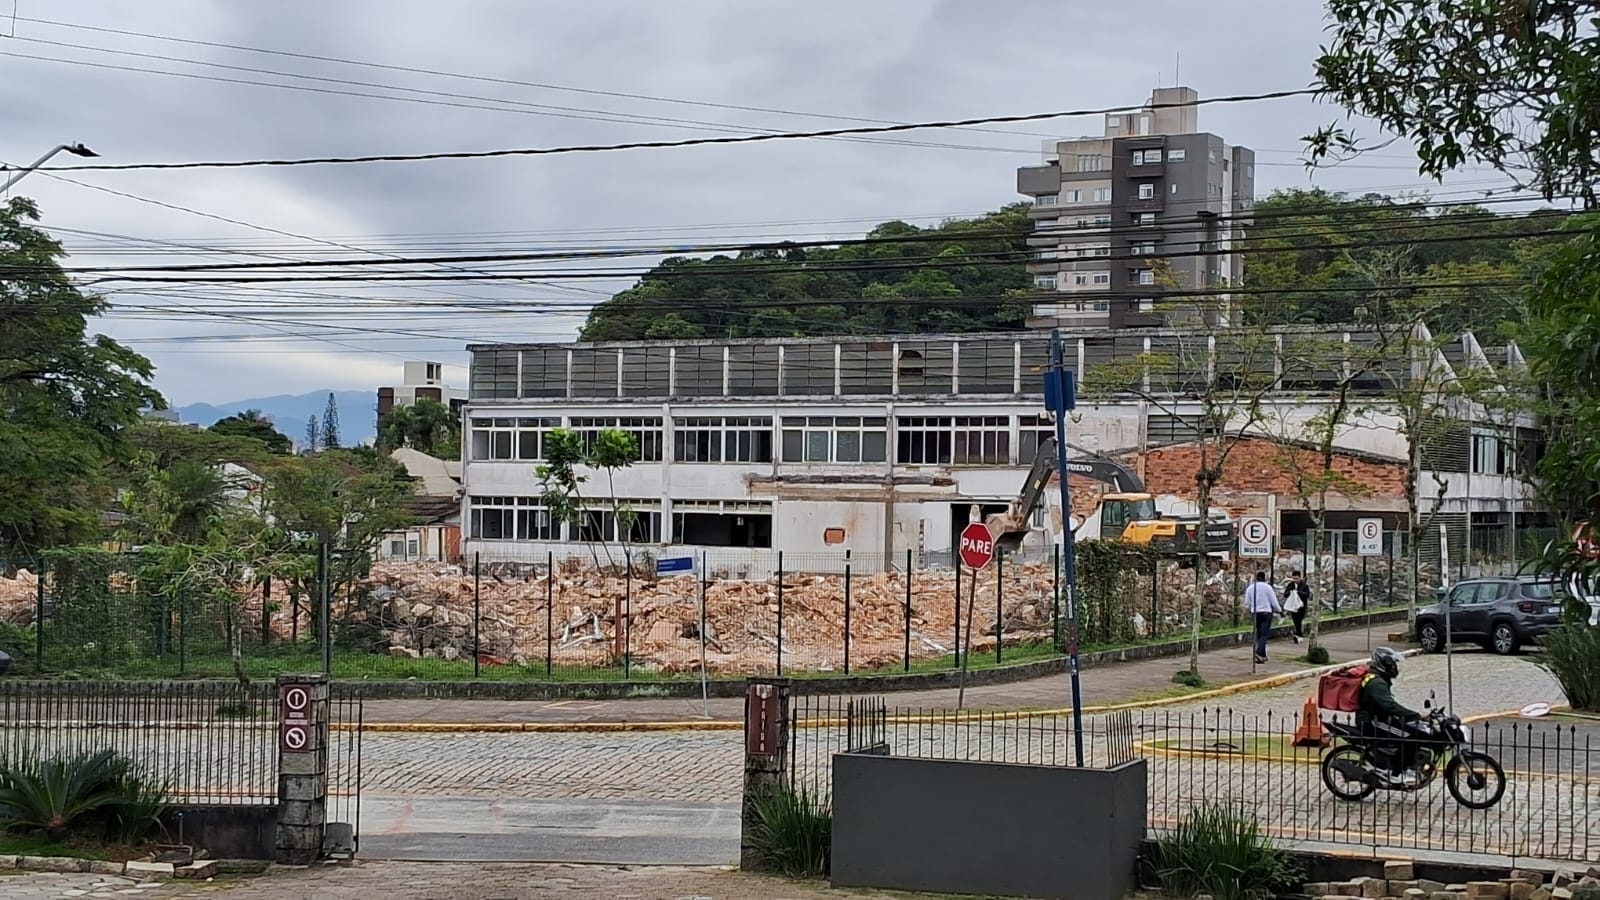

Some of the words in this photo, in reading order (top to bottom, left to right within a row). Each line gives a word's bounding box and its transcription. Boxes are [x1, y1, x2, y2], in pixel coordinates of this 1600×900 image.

[1065, 463, 1093, 473] VOLVO
[1250, 524, 1261, 539] E
[1367, 525, 1374, 536] E
[962, 537, 992, 555] PARE
